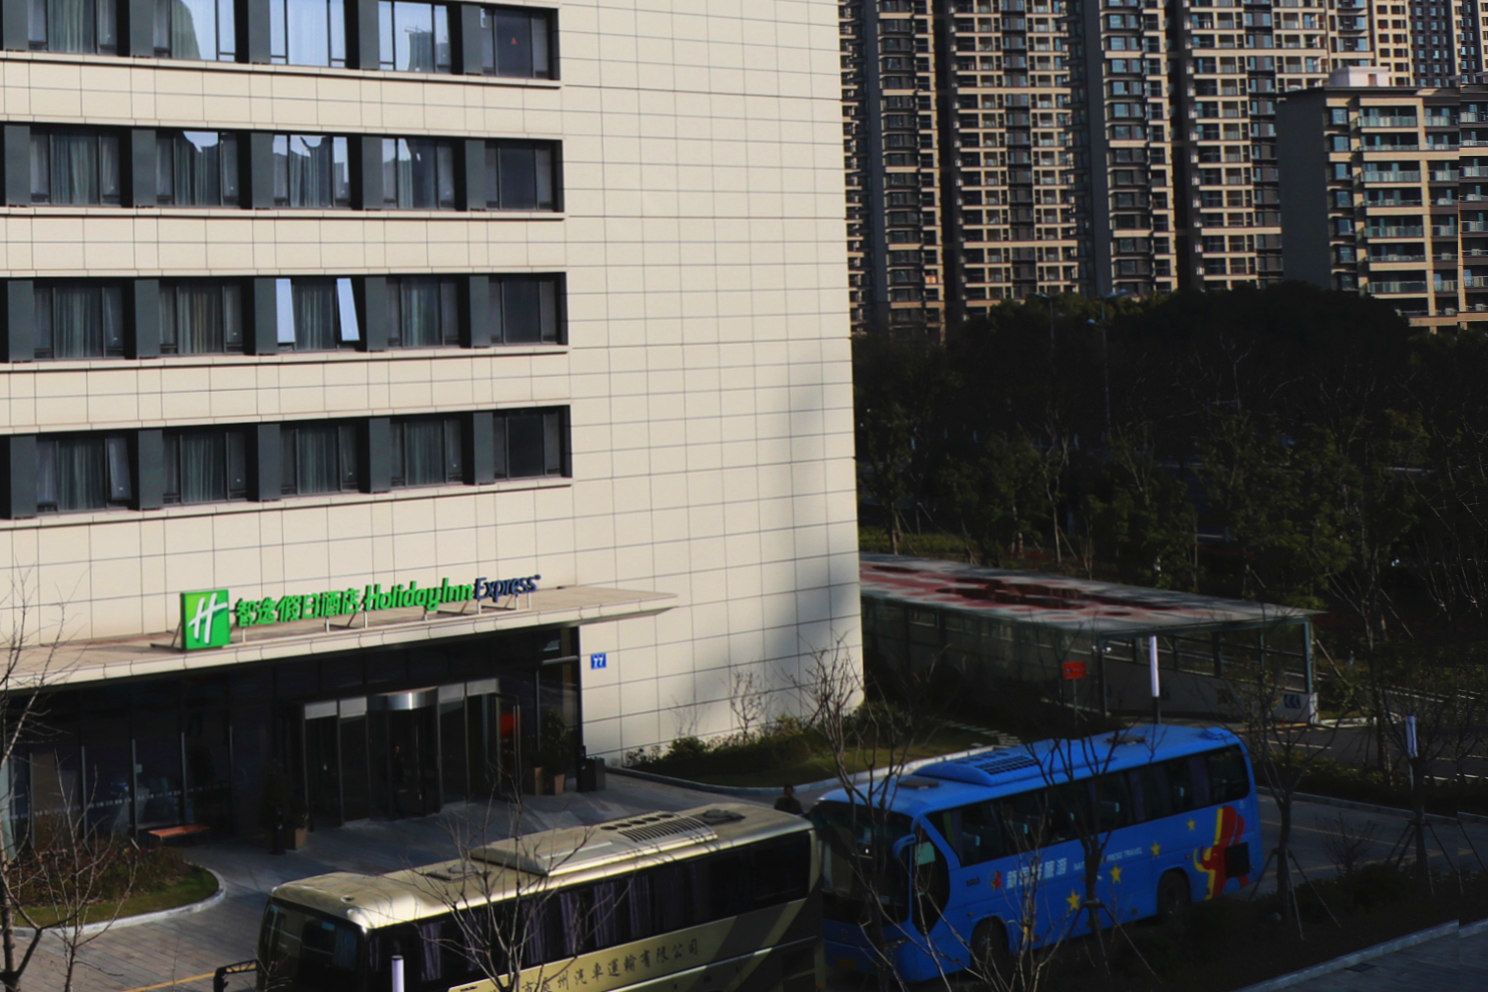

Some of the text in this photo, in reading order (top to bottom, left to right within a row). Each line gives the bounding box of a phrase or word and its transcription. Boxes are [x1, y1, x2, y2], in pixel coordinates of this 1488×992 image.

[235, 587, 362, 628] 智选假日酒店
[362, 580, 440, 612] Holiday
[473, 575, 538, 604] Express
